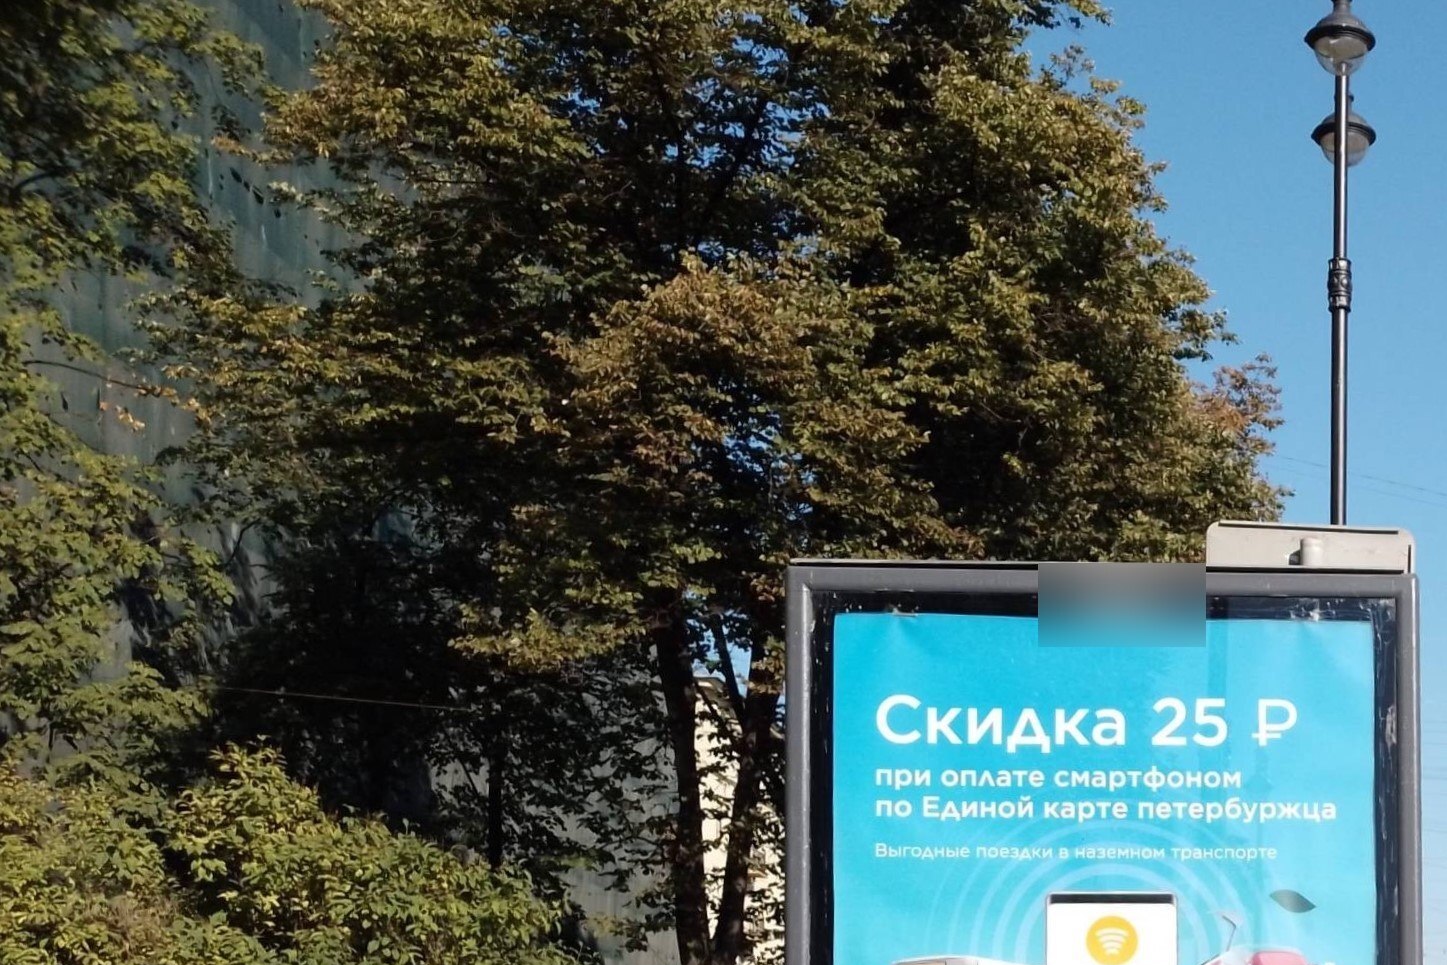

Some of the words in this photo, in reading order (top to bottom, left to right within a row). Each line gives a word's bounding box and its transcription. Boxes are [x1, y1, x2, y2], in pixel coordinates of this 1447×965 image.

[876, 694, 1125, 753] Скидка
[1152, 697, 1227, 746] 25
[876, 769, 931, 790] при
[941, 770, 1044, 787] оплате
[1054, 766, 1242, 791] смартфоном
[876, 800, 912, 817] по
[923, 796, 1033, 821] Единой
[1044, 802, 1127, 823] карте
[1139, 797, 1336, 823] петербуржца
[875, 843, 970, 859] Выгодные
[977, 847, 1053, 860] поездки
[1057, 848, 1070, 859] в
[1076, 848, 1164, 858] наземном
[1172, 847, 1278, 861] транспорте
